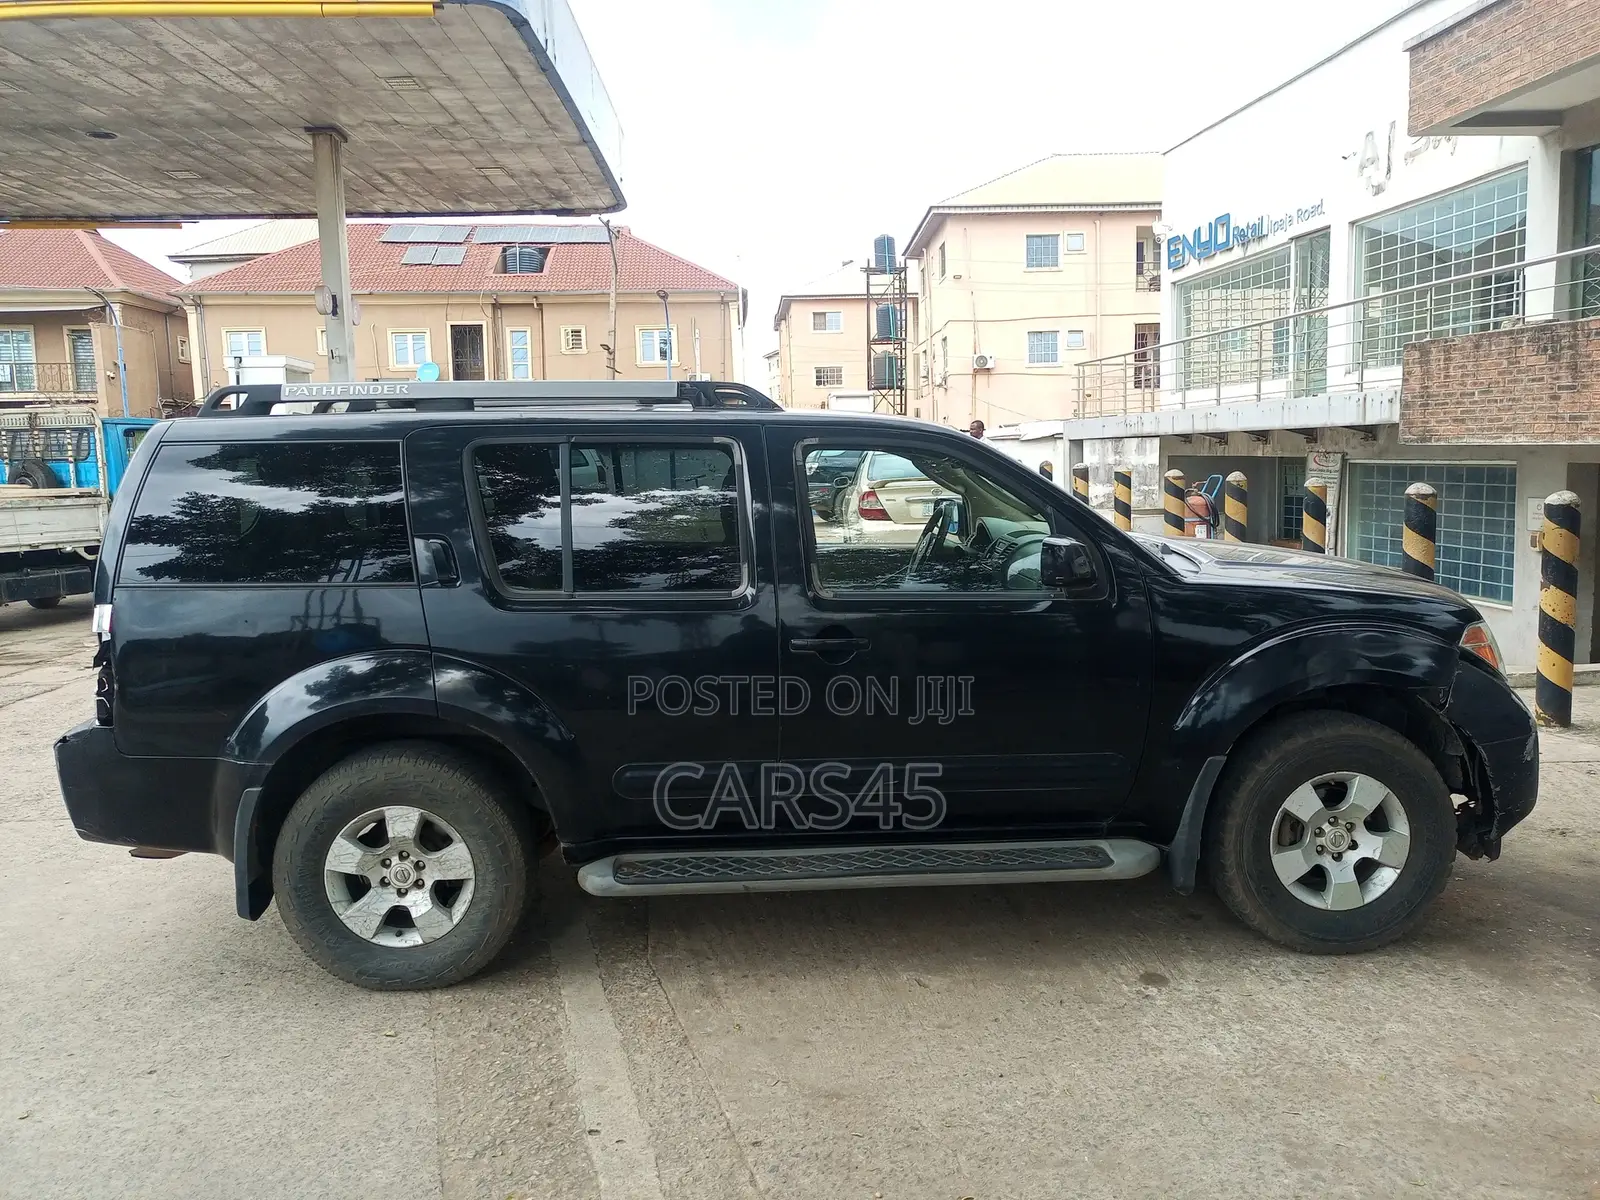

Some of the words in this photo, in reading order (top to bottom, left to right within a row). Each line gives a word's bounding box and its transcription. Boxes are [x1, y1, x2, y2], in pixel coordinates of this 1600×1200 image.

[1167, 212, 1231, 270] ENYO
[1232, 215, 1264, 246] Retail
[1269, 213, 1294, 237] Ipaja
[284, 384, 409, 396] PATHFINDER
